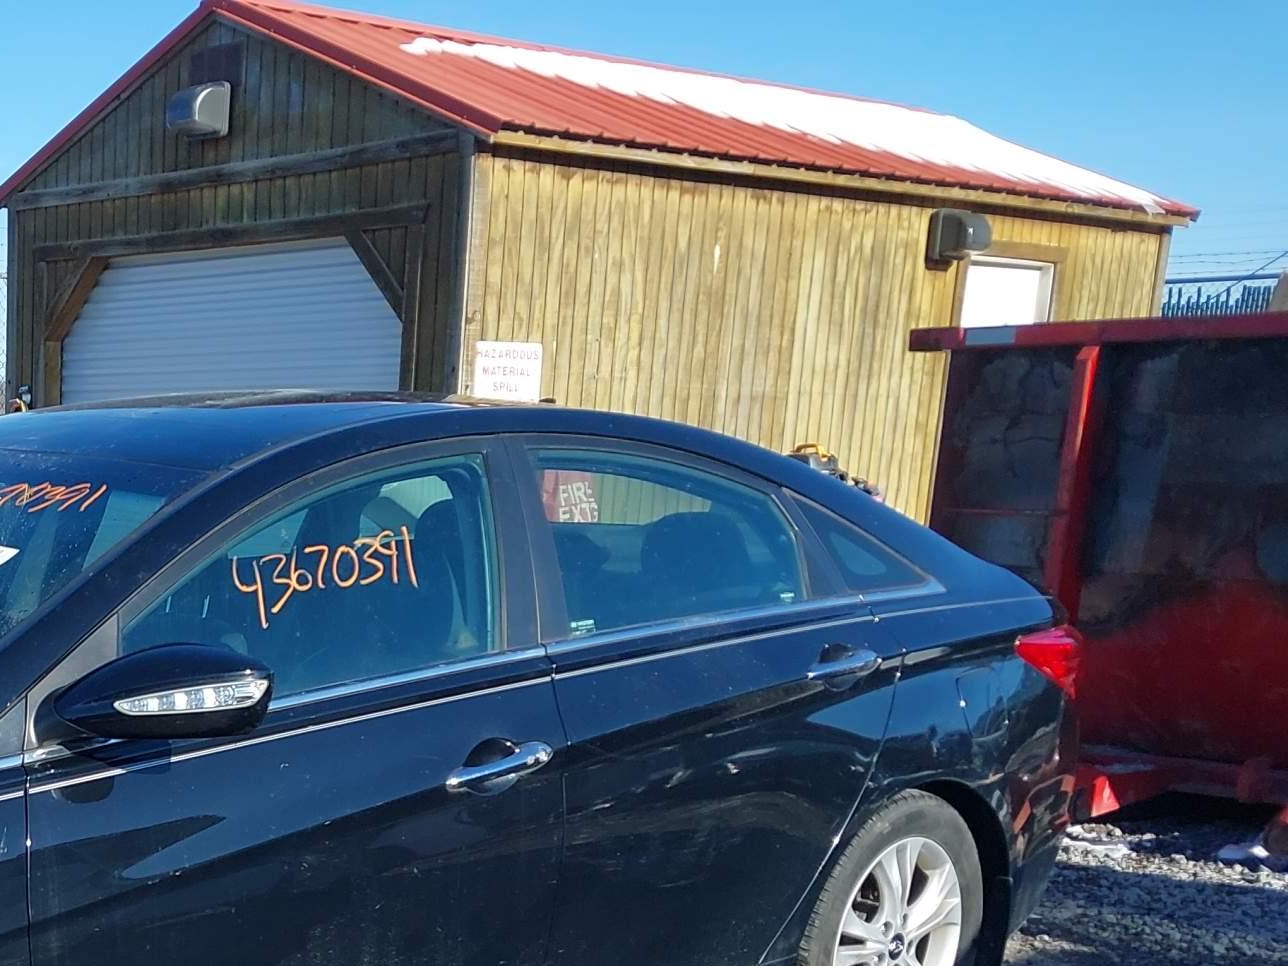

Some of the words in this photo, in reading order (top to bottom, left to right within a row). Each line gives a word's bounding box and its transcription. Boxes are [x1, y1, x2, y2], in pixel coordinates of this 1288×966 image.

[482, 366, 531, 377] MATERIAL
[493, 382, 519, 392] SPILL
[232, 525, 419, 629] 43670391
